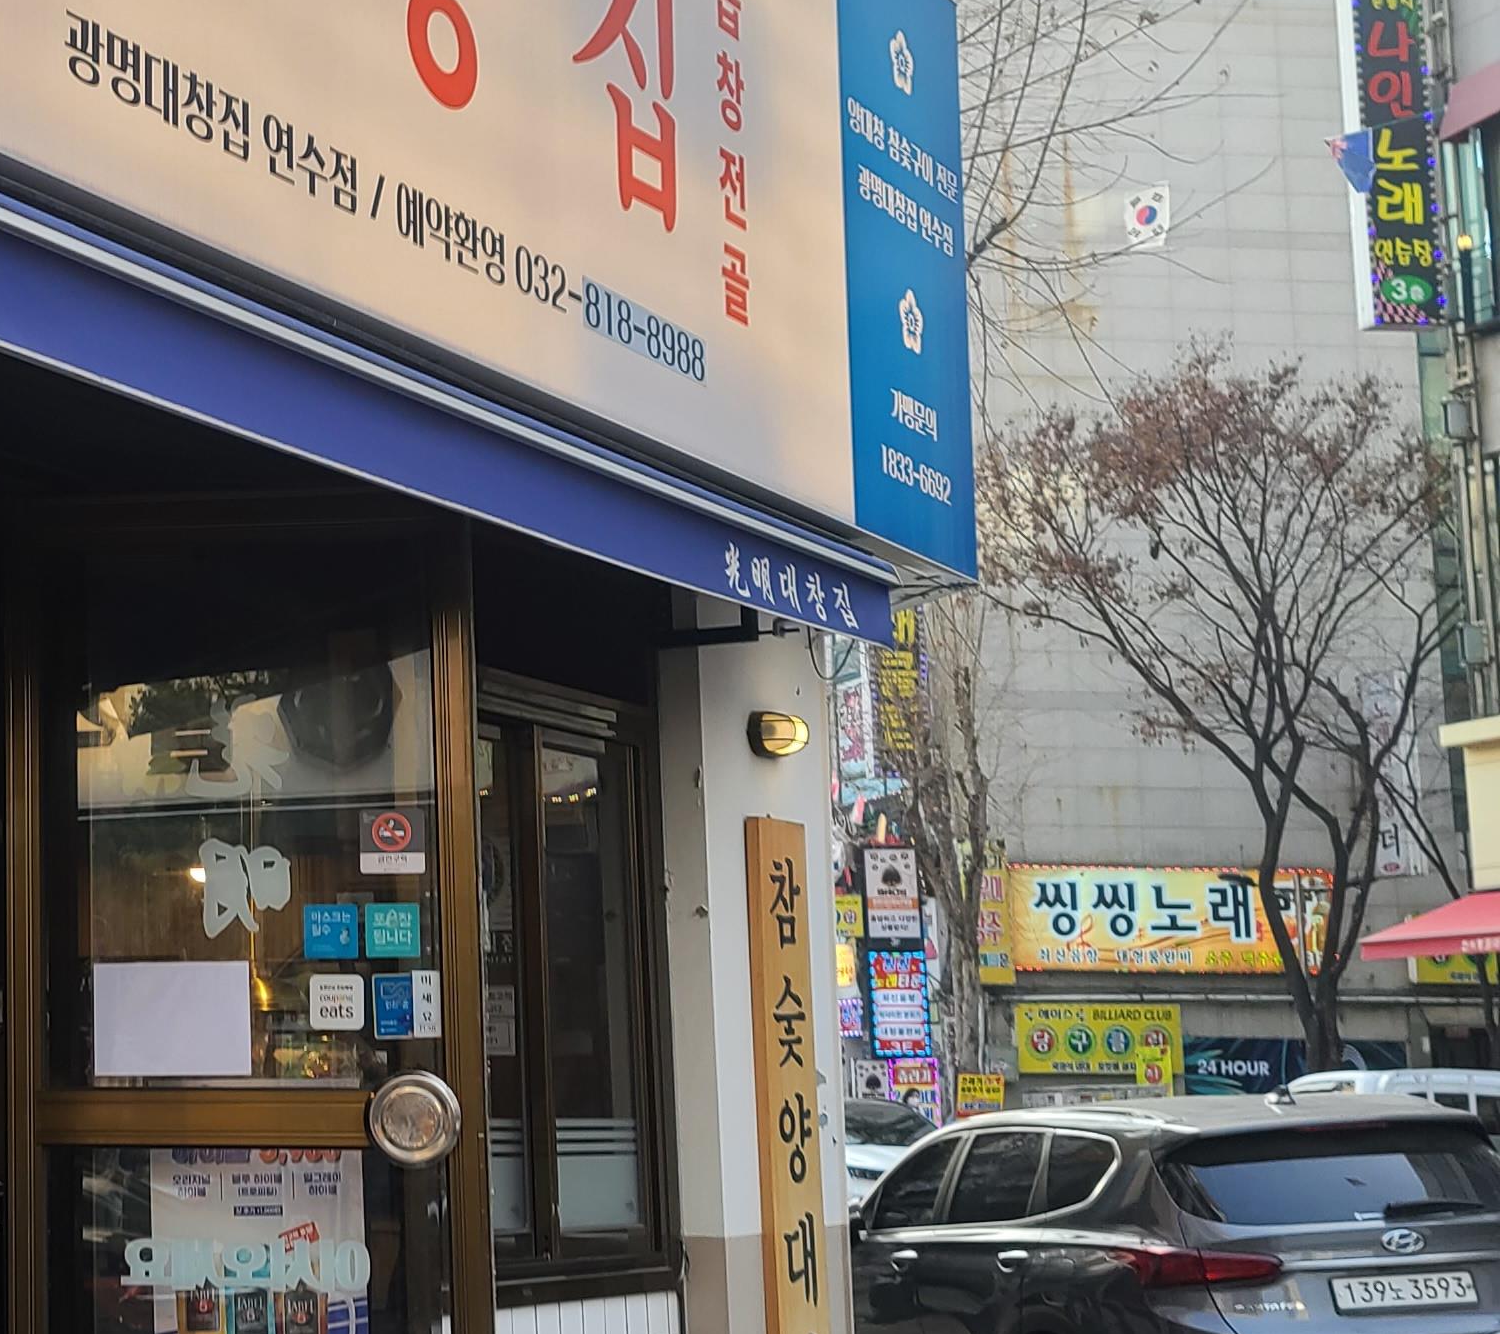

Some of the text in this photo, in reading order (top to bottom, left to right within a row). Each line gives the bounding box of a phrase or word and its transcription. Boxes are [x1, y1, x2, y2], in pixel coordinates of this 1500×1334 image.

[1366, 19, 1416, 119] 나인
[847, 97, 959, 205] 양대창 참숯구이 전문
[1374, 127, 1425, 226] 노래
[64, 8, 251, 163] 광명대창집
[262, 112, 358, 217] 연수점
[396, 180, 507, 287] 예약환영
[514, 244, 707, 384] 032-818-8988
[857, 163, 955, 258] 광명대창집 연수점
[1374, 239, 1434, 268] 연습장
[890, 387, 938, 443] 가맹문의
[880, 443, 953, 507] 1833-6692
[723, 539, 860, 631] 光明대창집
[320, 1004, 354, 1019] eats
[1092, 1008, 1141, 1021] BILLIARD
[1144, 1009, 1172, 1021] CLUB
[1197, 1059, 1270, 1077] 24 HOUR
